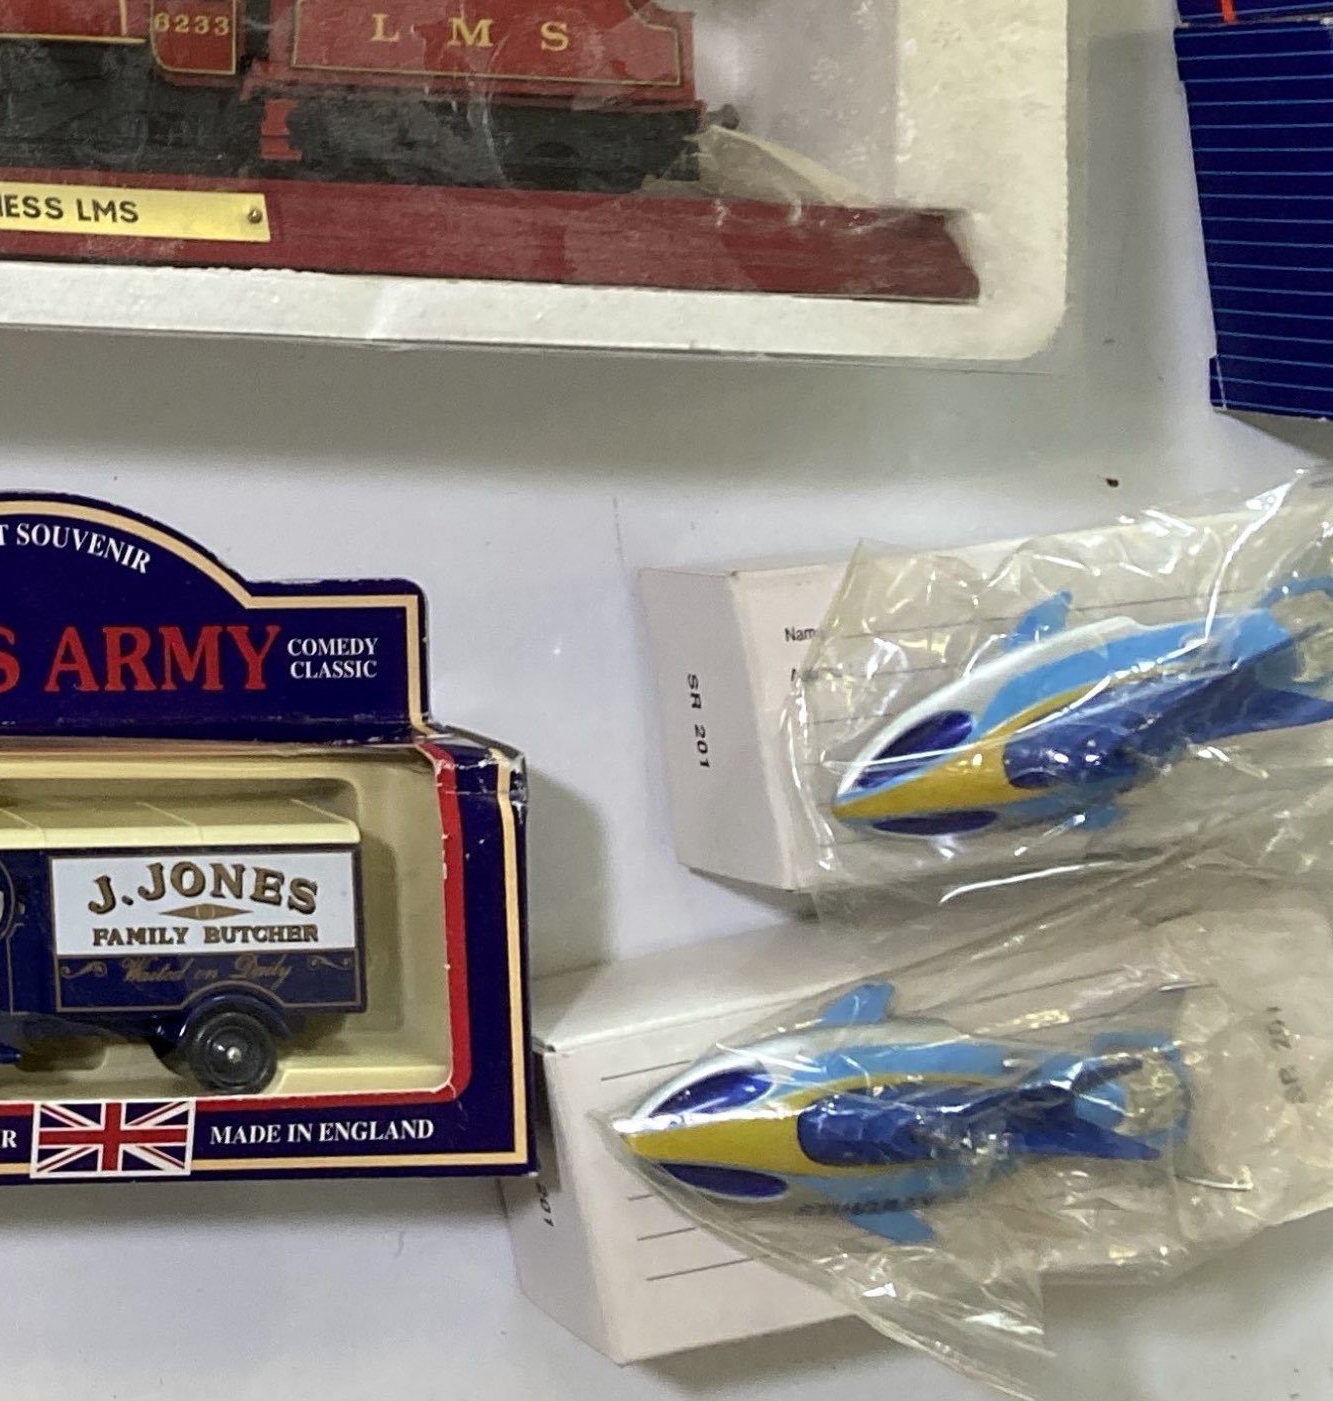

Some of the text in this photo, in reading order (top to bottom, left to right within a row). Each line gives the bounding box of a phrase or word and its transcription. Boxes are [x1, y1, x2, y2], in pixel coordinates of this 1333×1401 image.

[154, 12, 230, 37] 6233
[371, 13, 569, 51] L M S
[76, 198, 139, 223] LMS
[16, 522, 153, 574] SOUVENIR
[784, 626, 817, 642] Nam
[44, 625, 281, 692] ARMY
[287, 637, 379, 657] COMEDY
[289, 659, 378, 680] CLASSIC
[686, 672, 711, 769] SR 201
[92, 924, 320, 947] FAMILY BUTCHER
[209, 1118, 435, 1145] MADE IN ENGLAND
